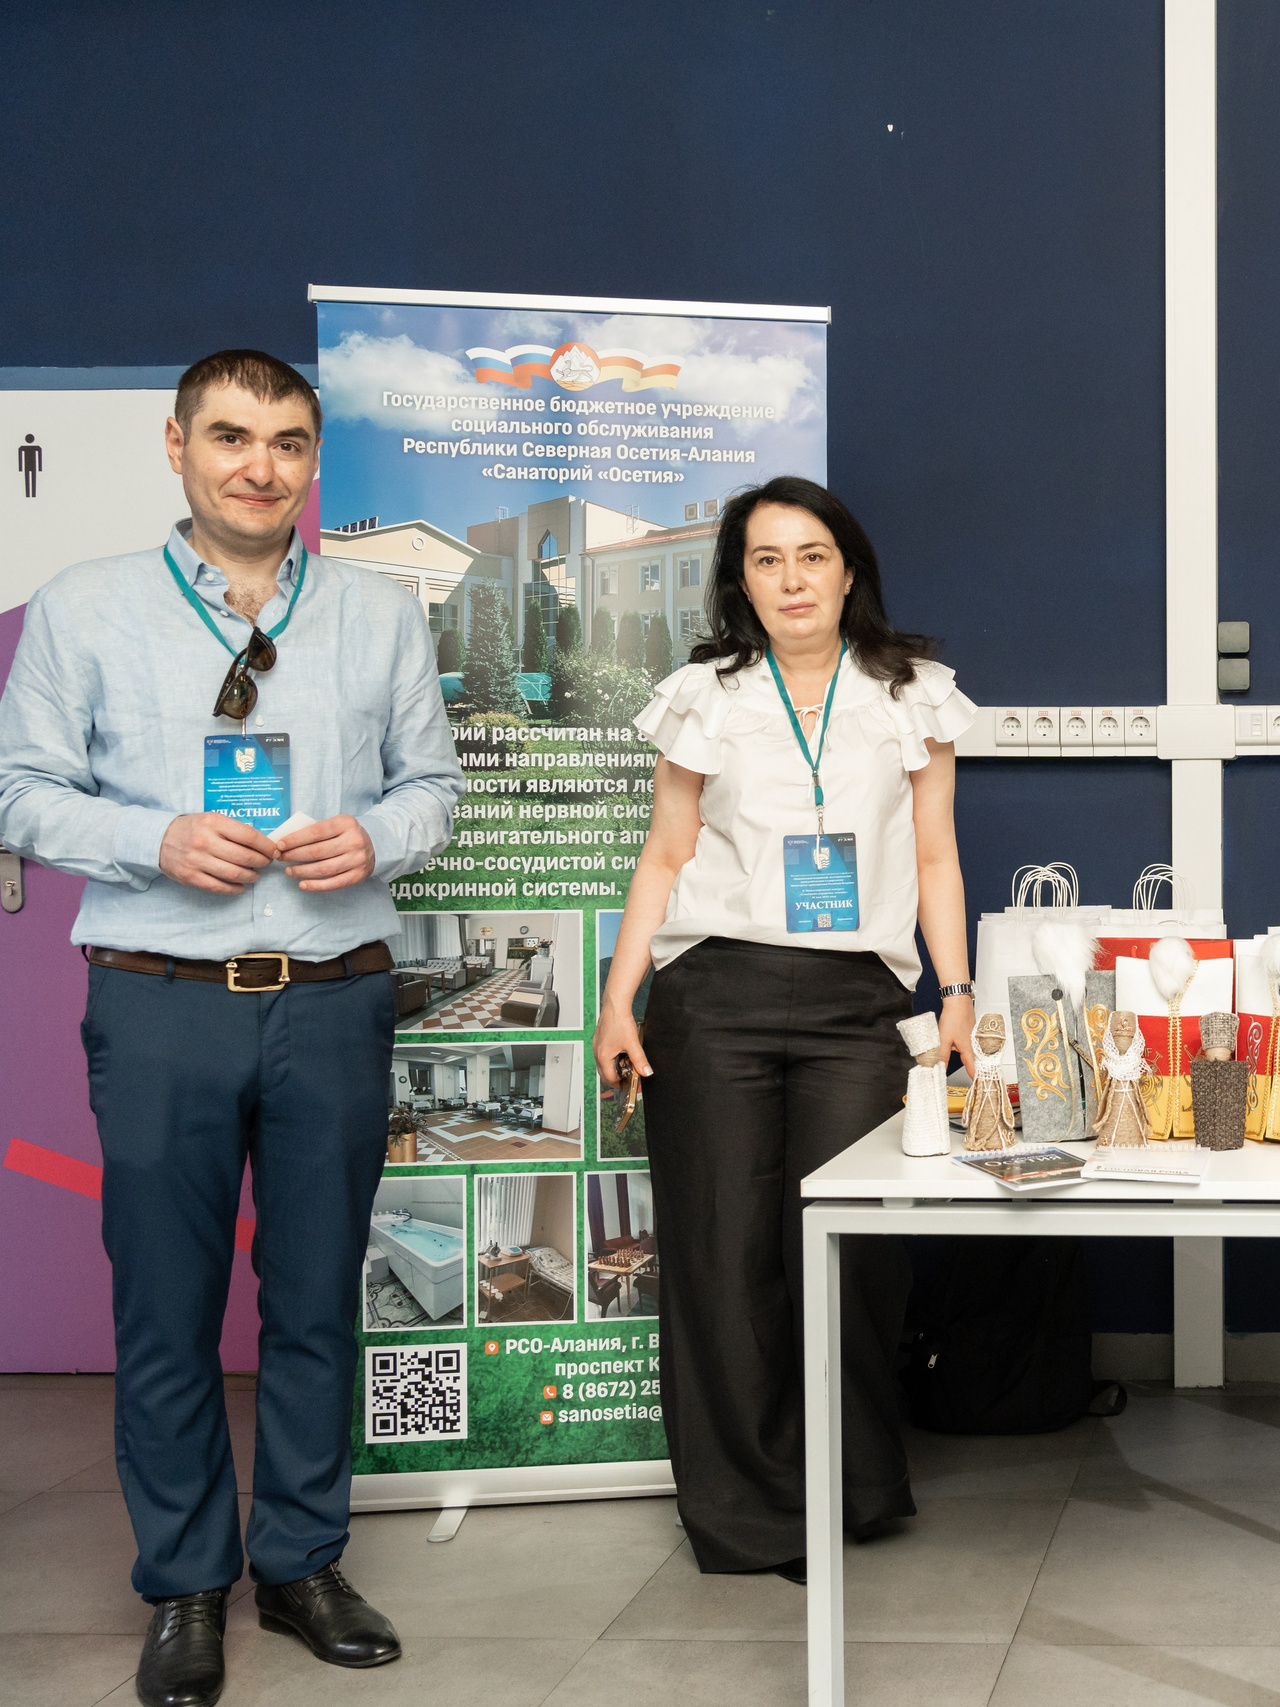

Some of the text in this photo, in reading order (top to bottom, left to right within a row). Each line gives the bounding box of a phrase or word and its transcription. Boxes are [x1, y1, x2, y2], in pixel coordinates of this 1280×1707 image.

[382, 391, 775, 420] Государственное бюджетное учреждение
[451, 418, 714, 440] социального обслуживания
[403, 438, 756, 463] Республики Северная Осетия-Алания
[482, 464, 685, 483] «Санаторий «Осетия»
[492, 726, 602, 745] рассчитан
[607, 727, 632, 741] на
[505, 752, 659, 770] направлениям
[526, 778, 628, 793] являются
[212, 807, 281, 818] ЧАСТНИК
[519, 801, 608, 822] нервной
[452, 830, 615, 848] -двигательного
[420, 851, 640, 874] ечно-сосудистой си
[522, 881, 622, 896] системы.
[795, 900, 853, 911] УЧАСТНИК
[505, 1337, 627, 1354] РСО-Алания,
[631, 1336, 644, 1349] г.
[555, 1360, 644, 1379] проспект
[562, 1384, 574, 1399] 8
[578, 1380, 637, 1402] (8672)
